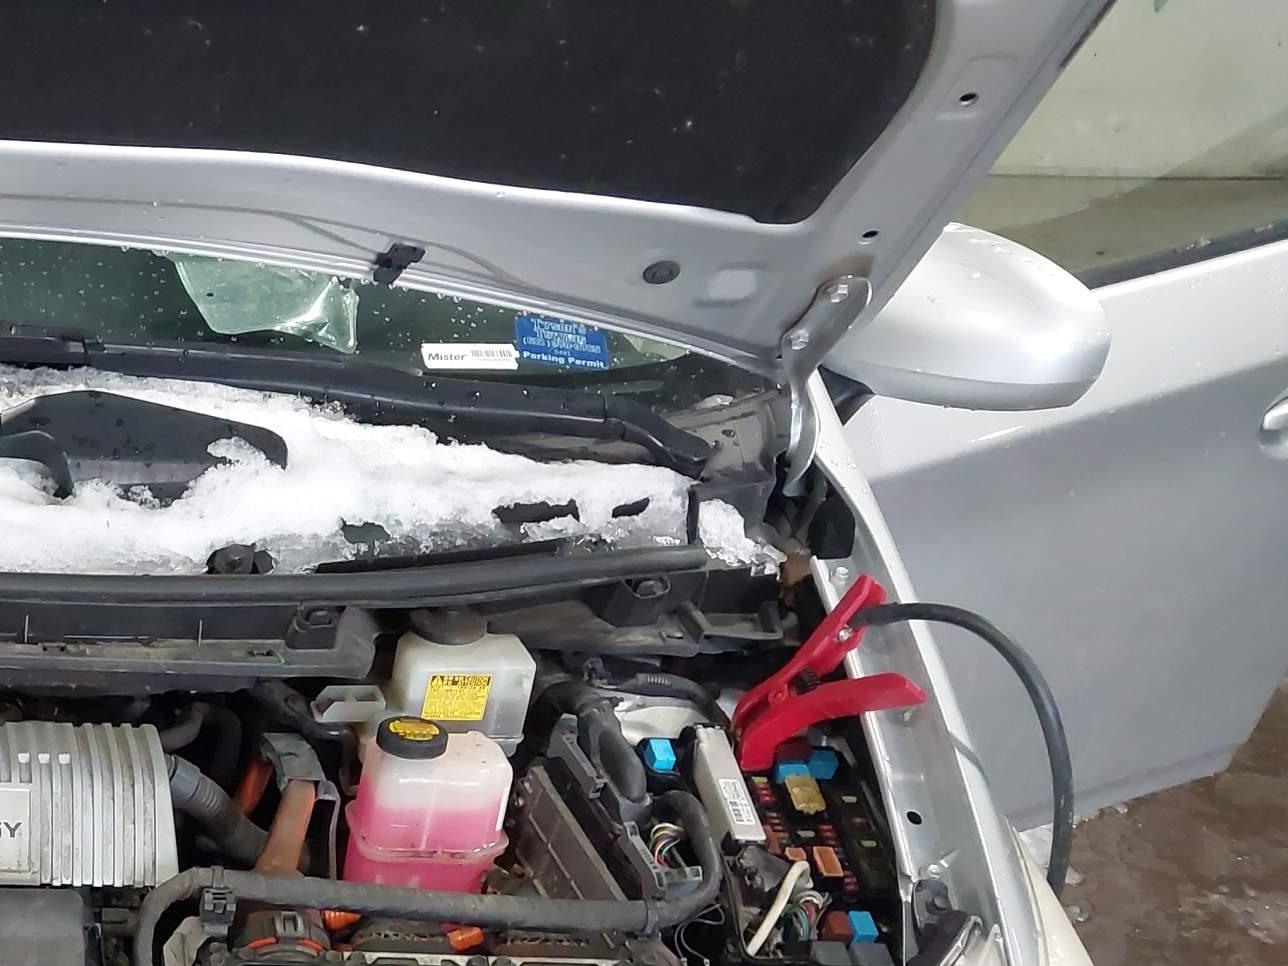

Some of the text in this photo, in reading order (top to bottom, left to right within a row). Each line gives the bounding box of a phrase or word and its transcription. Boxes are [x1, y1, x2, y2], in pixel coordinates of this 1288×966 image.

[428, 352, 467, 361] Mister
[523, 350, 565, 364] Parking
[567, 357, 605, 369] Permit
